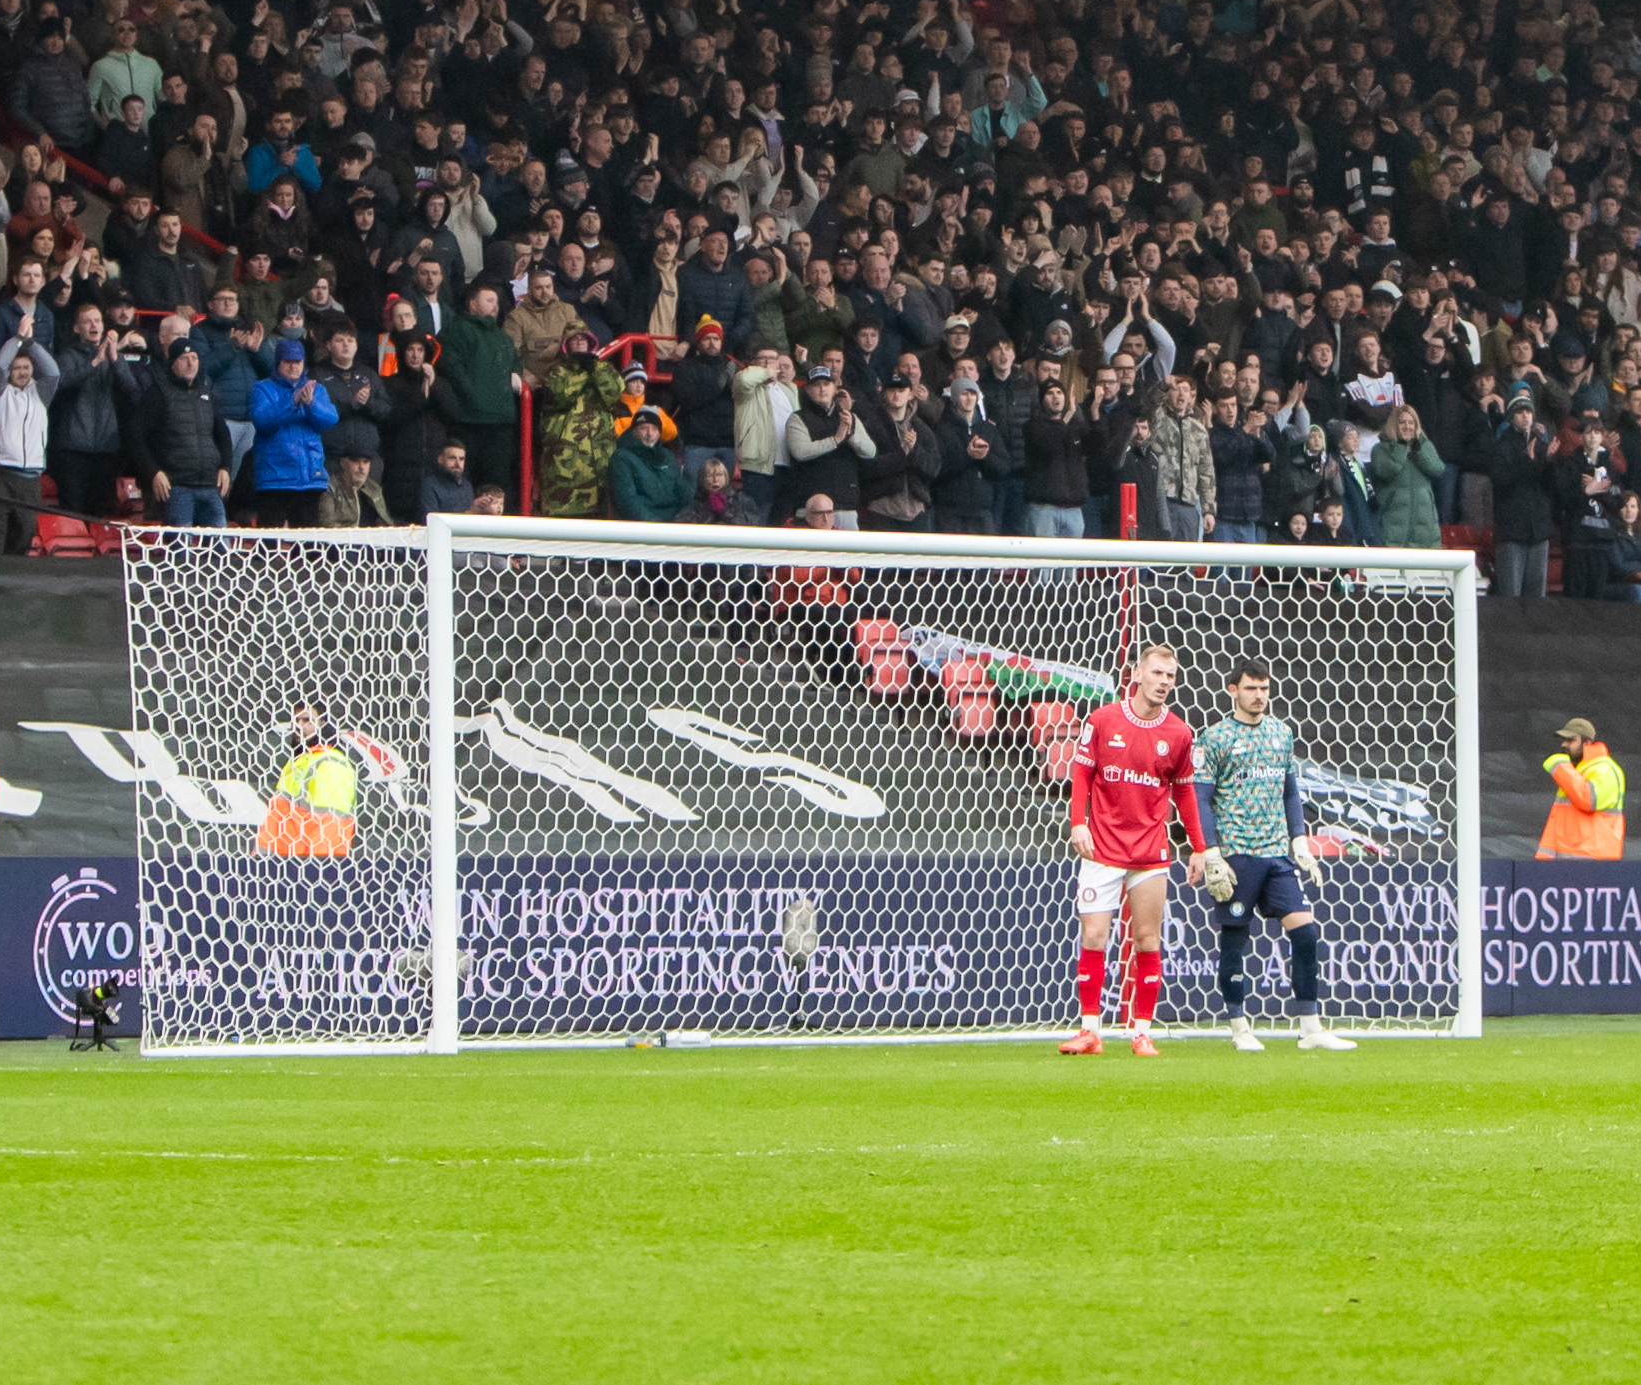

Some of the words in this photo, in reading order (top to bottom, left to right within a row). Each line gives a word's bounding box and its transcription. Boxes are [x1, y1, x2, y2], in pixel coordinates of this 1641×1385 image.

[57, 902, 166, 960] wob
[256, 948, 322, 1000] AT
[525, 946, 761, 996] SPORTING
